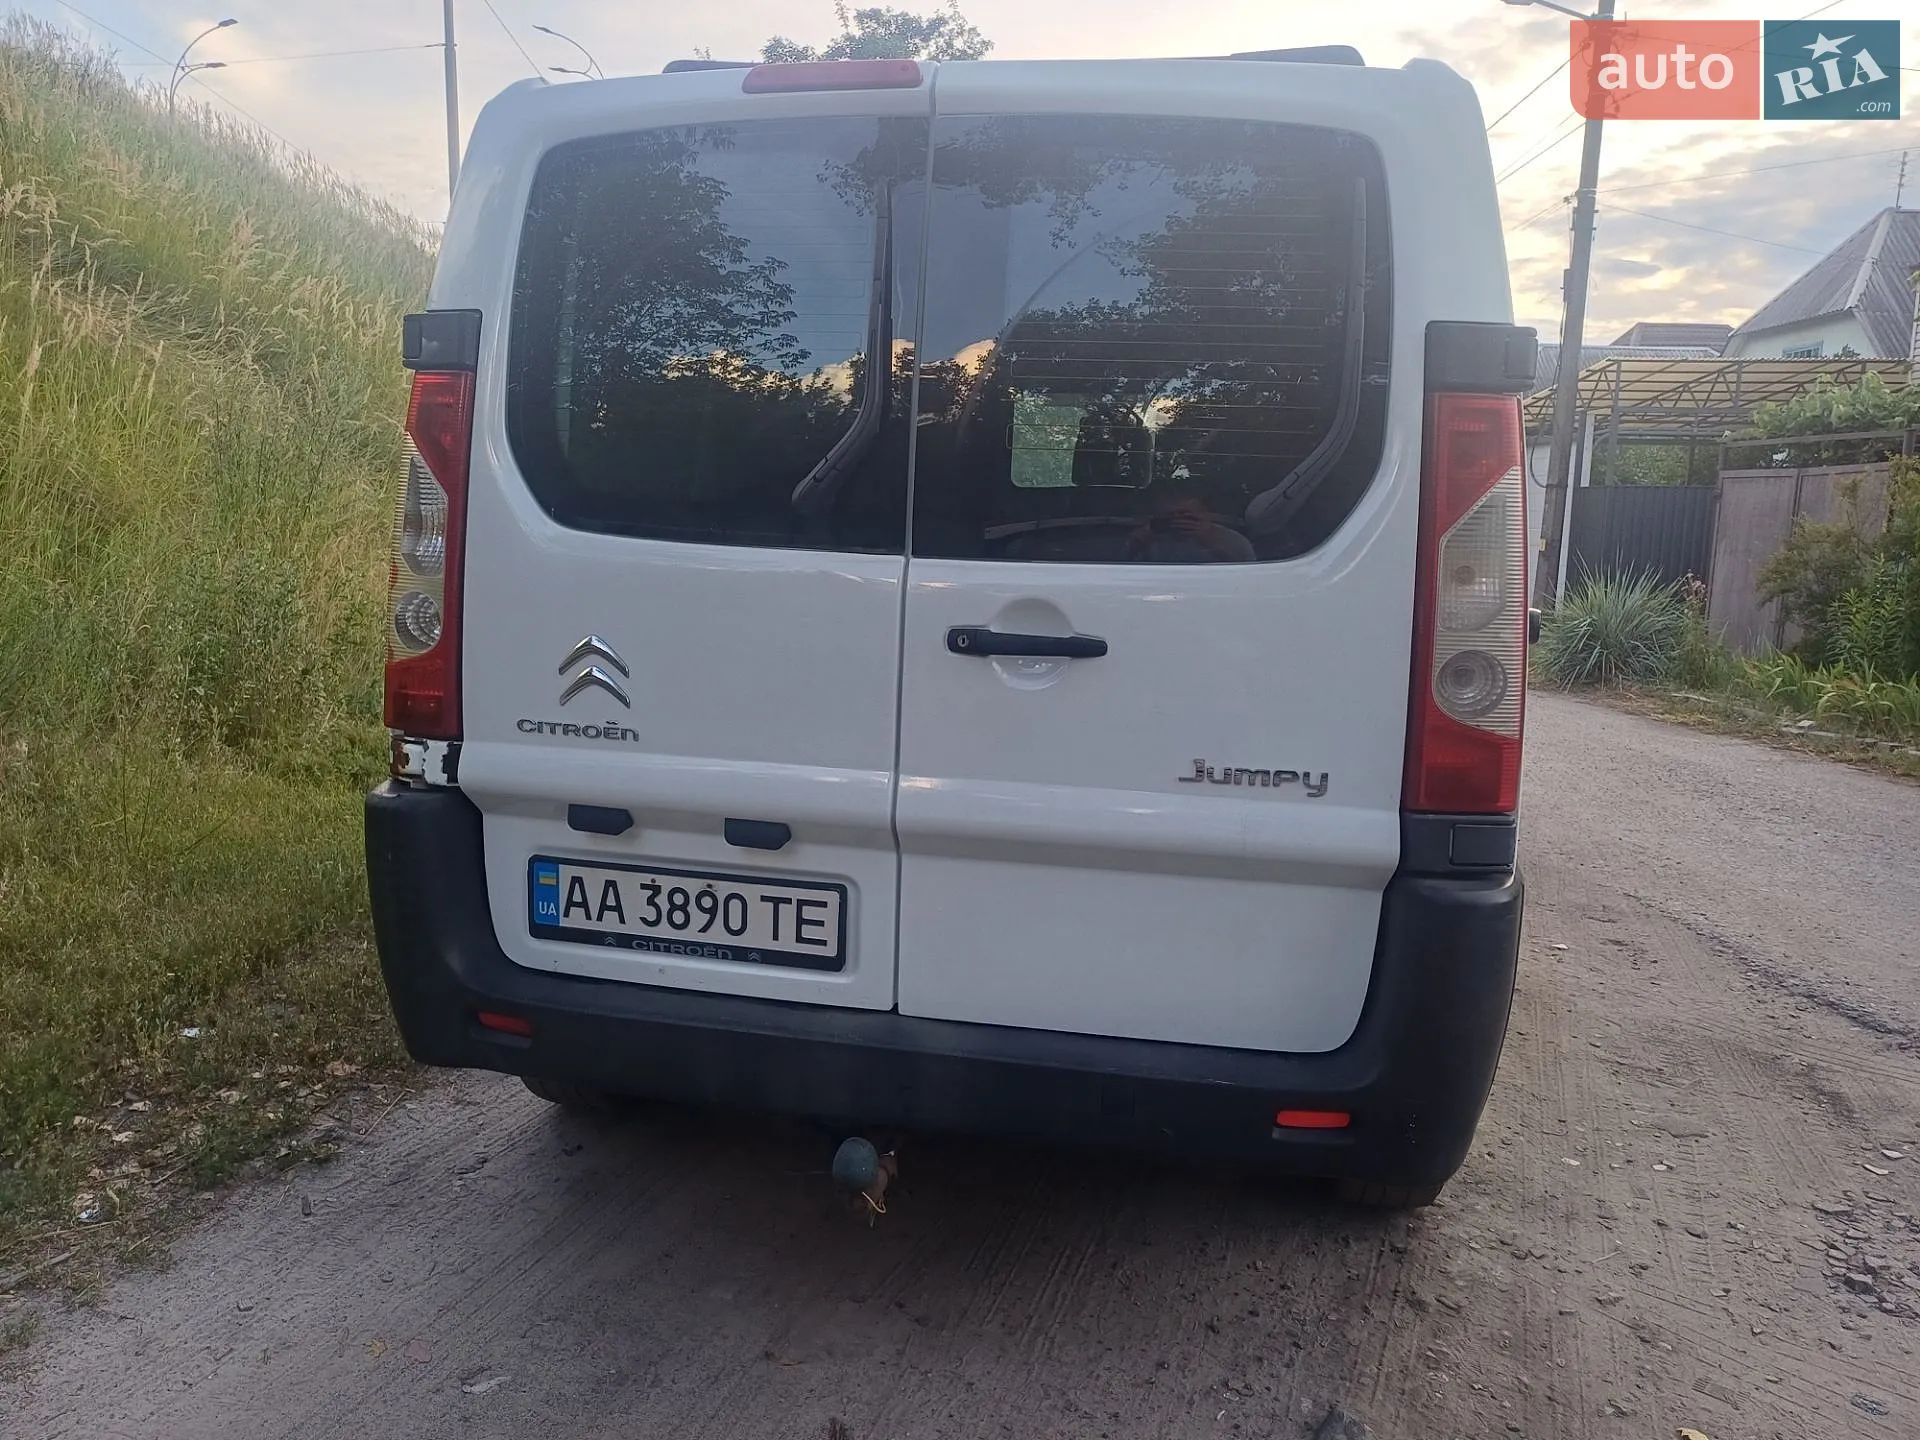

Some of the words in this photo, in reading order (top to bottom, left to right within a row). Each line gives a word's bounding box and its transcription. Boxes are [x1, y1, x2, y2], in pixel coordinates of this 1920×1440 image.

[539, 901, 557, 917] UA
[563, 876, 627, 925] AA
[639, 882, 749, 937] 3890
[759, 894, 829, 947] TE
